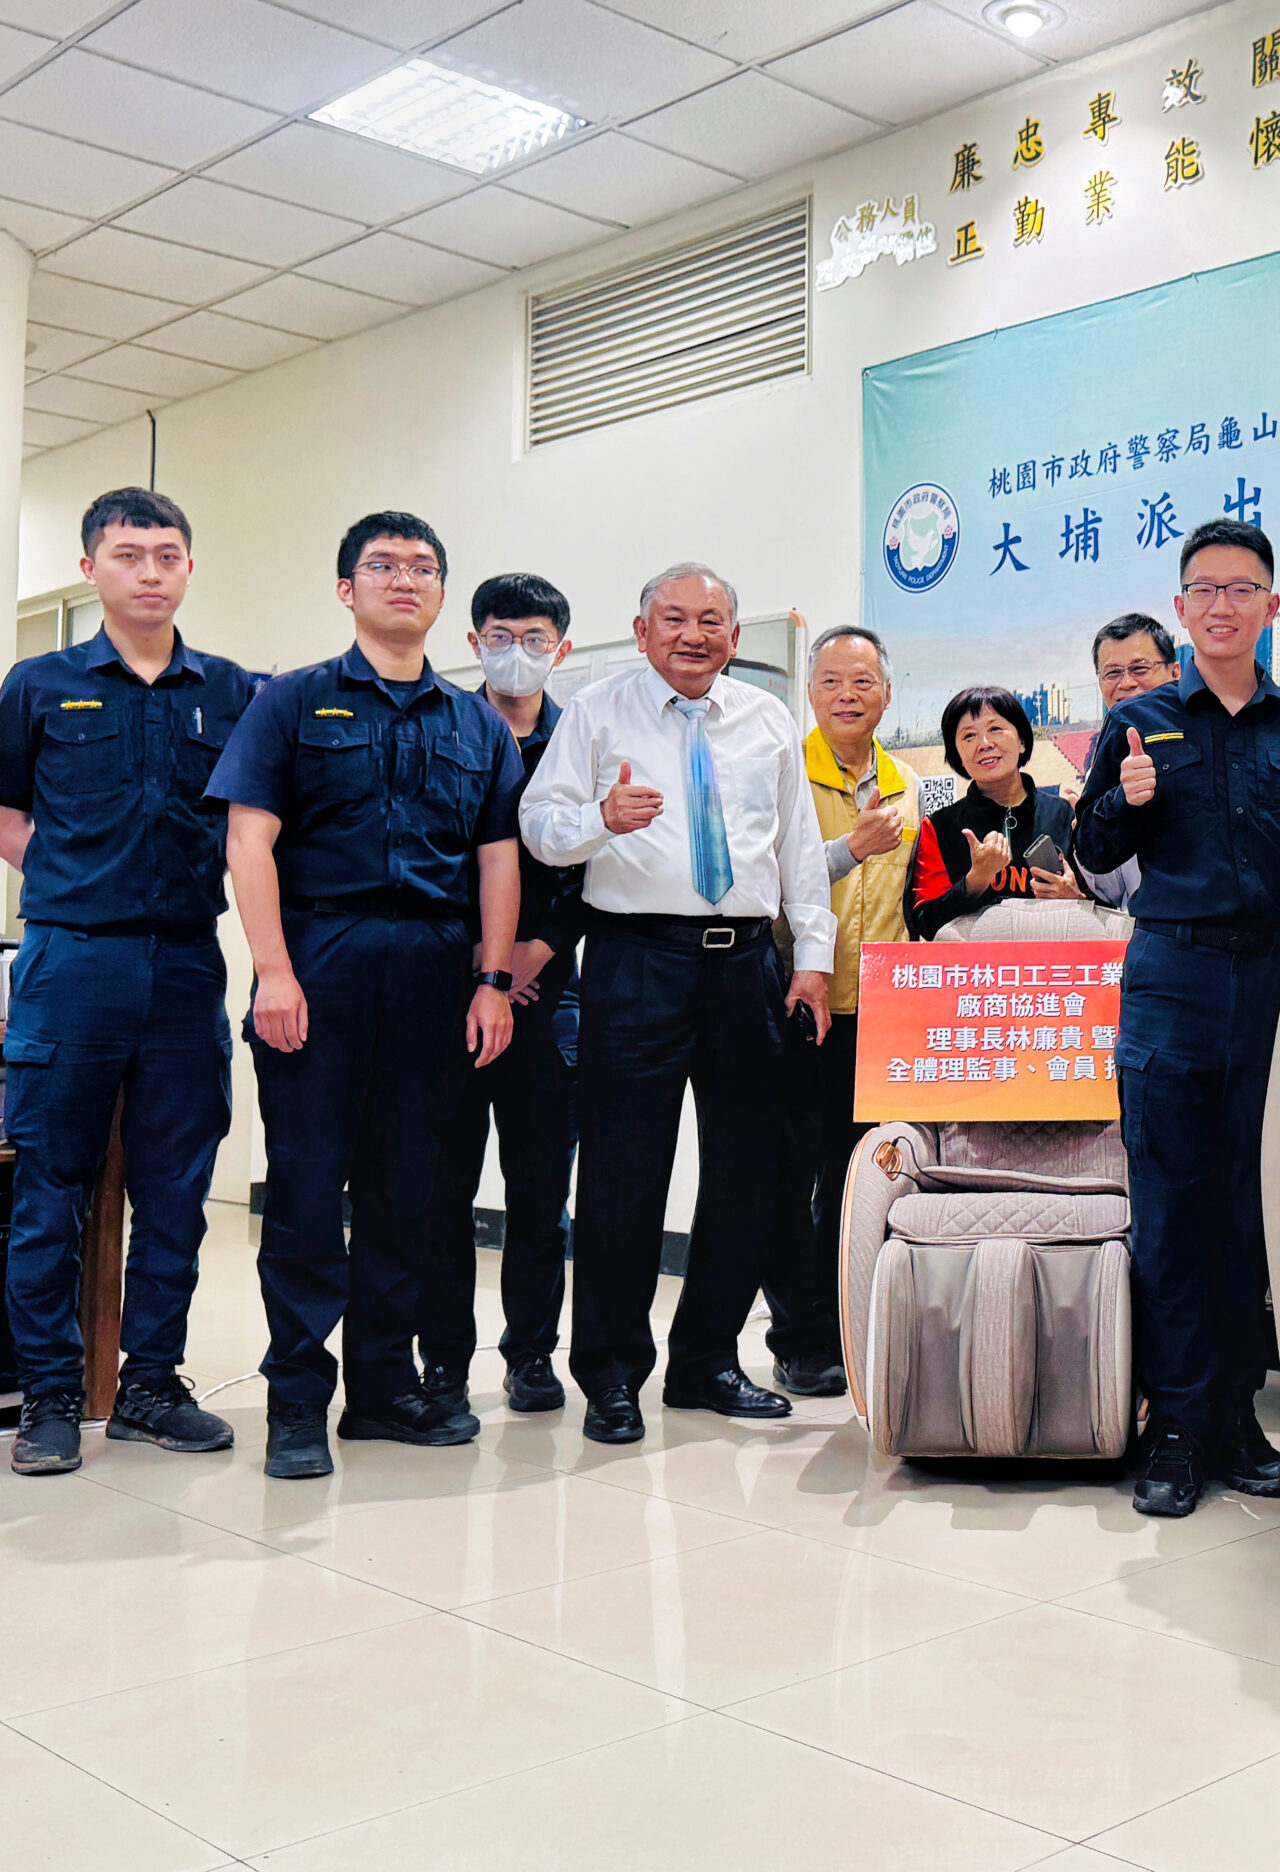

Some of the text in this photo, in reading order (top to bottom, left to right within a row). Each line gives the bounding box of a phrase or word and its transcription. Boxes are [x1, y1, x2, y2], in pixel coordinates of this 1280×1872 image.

[1084, 92, 1121, 223] 專業
[1163, 59, 1205, 190] 效能
[949, 143, 984, 264] 廉正
[1012, 117, 1045, 246] 忠勤
[892, 962, 1123, 989] 桃園市林口工三工業
[957, 992, 1087, 1018] 廠商協進會
[886, 1056, 1098, 1083] 全體理監事、會員
[926, 1025, 1116, 1052] 理事長林廉貴 暨
